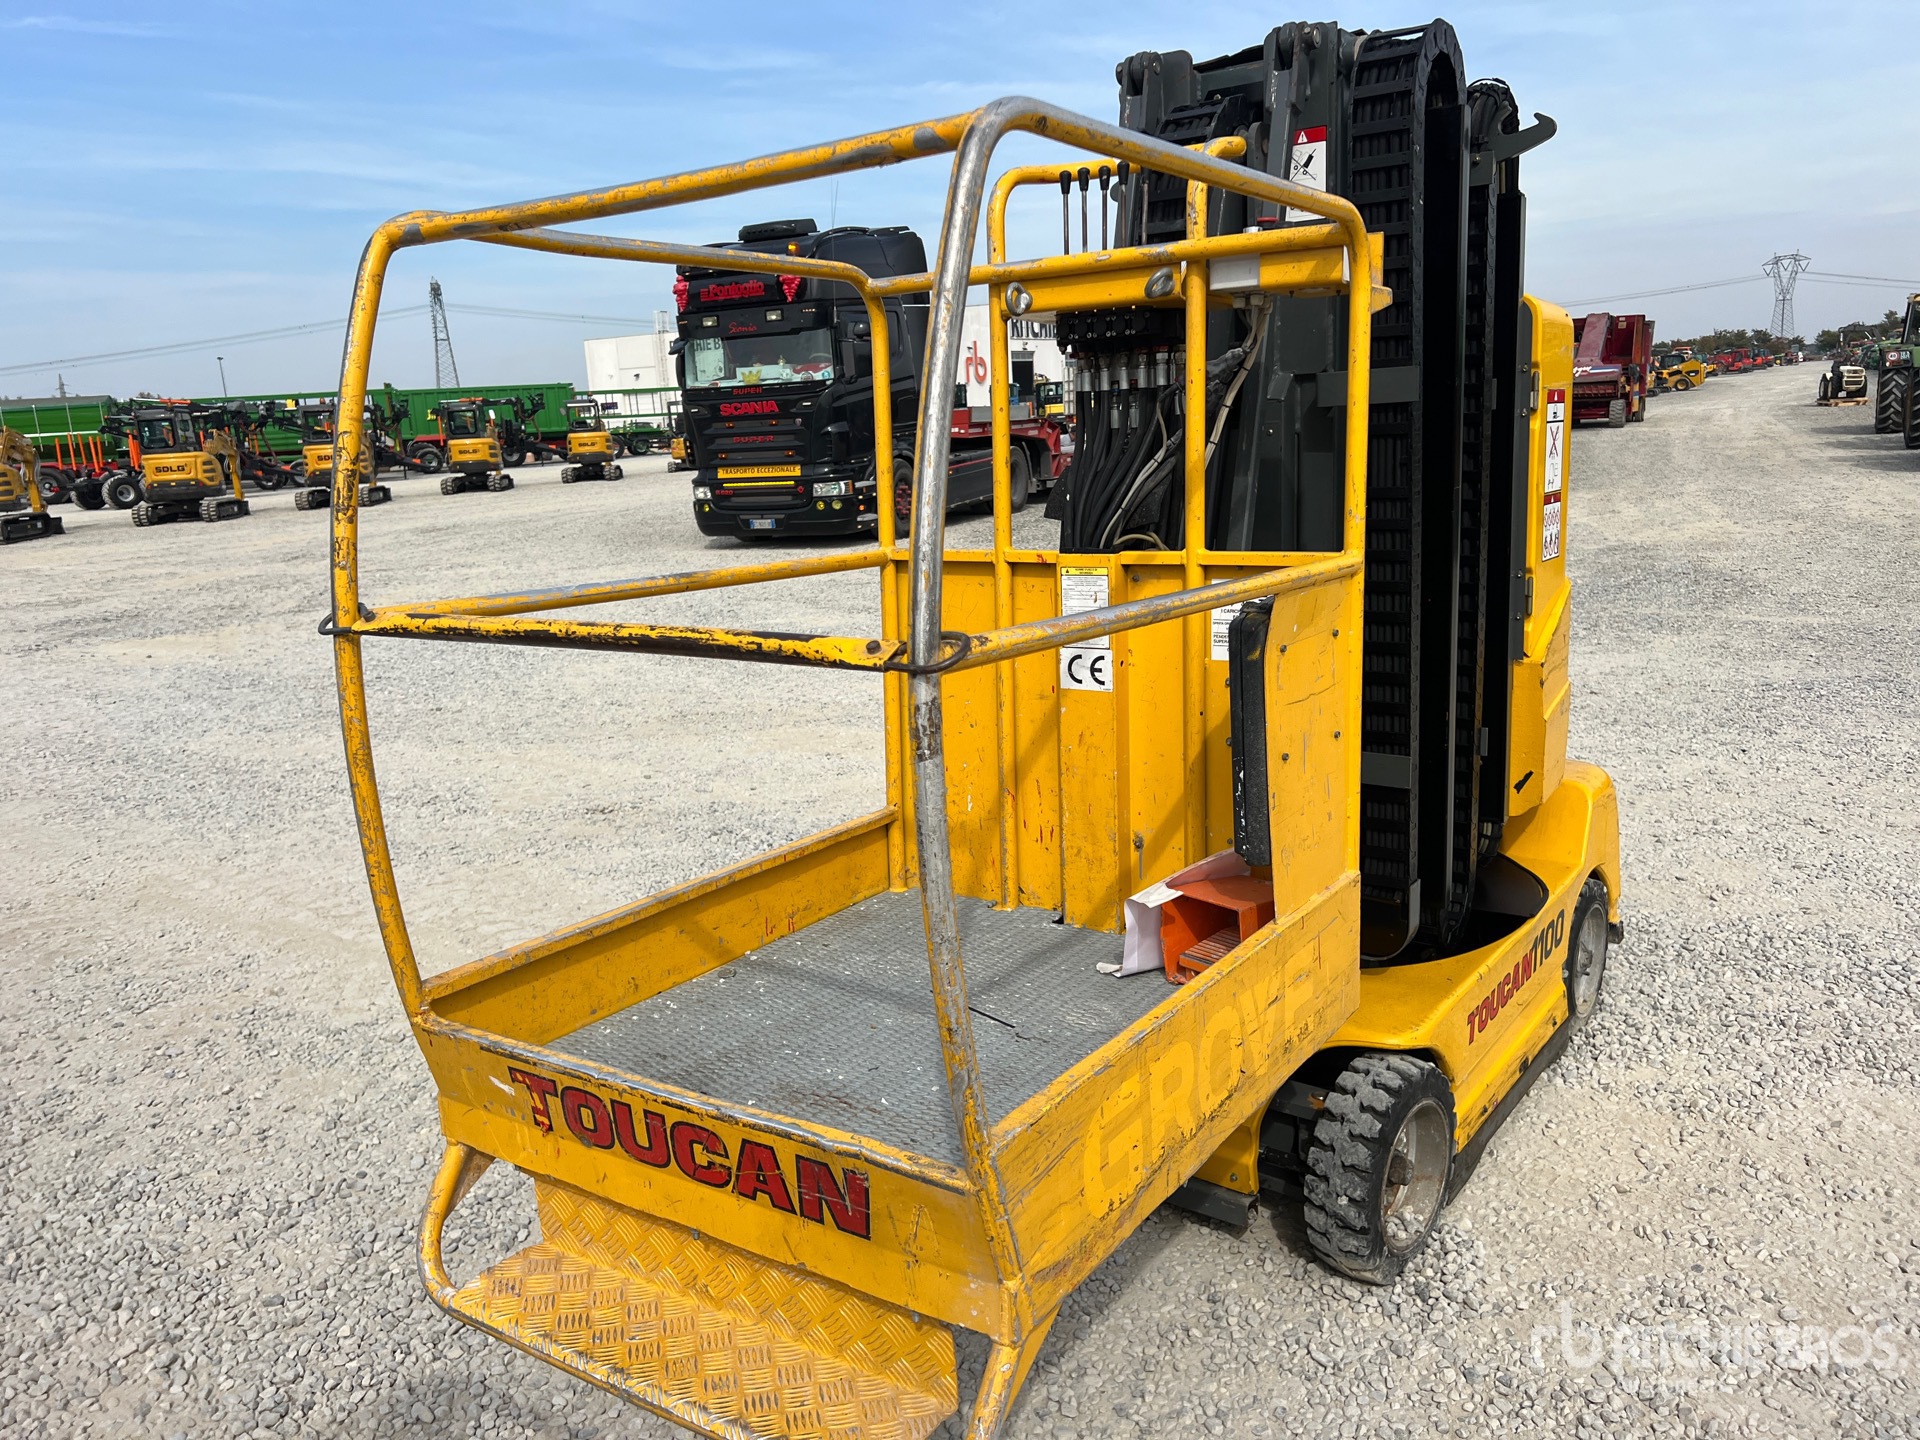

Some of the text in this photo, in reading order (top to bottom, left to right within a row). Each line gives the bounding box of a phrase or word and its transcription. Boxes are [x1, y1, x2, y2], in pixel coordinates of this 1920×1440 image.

[709, 280, 765, 298] Pontoglio
[965, 340, 988, 385] rb
[720, 400, 780, 416] SCANIA
[733, 435, 776, 443] SUPER
[155, 465, 186, 473] SDLG
[722, 466, 797, 475] TRASPORTO ECCEZIONALE
[1067, 653, 1106, 686] CE
[507, 1065, 871, 1241] TOUCAN
